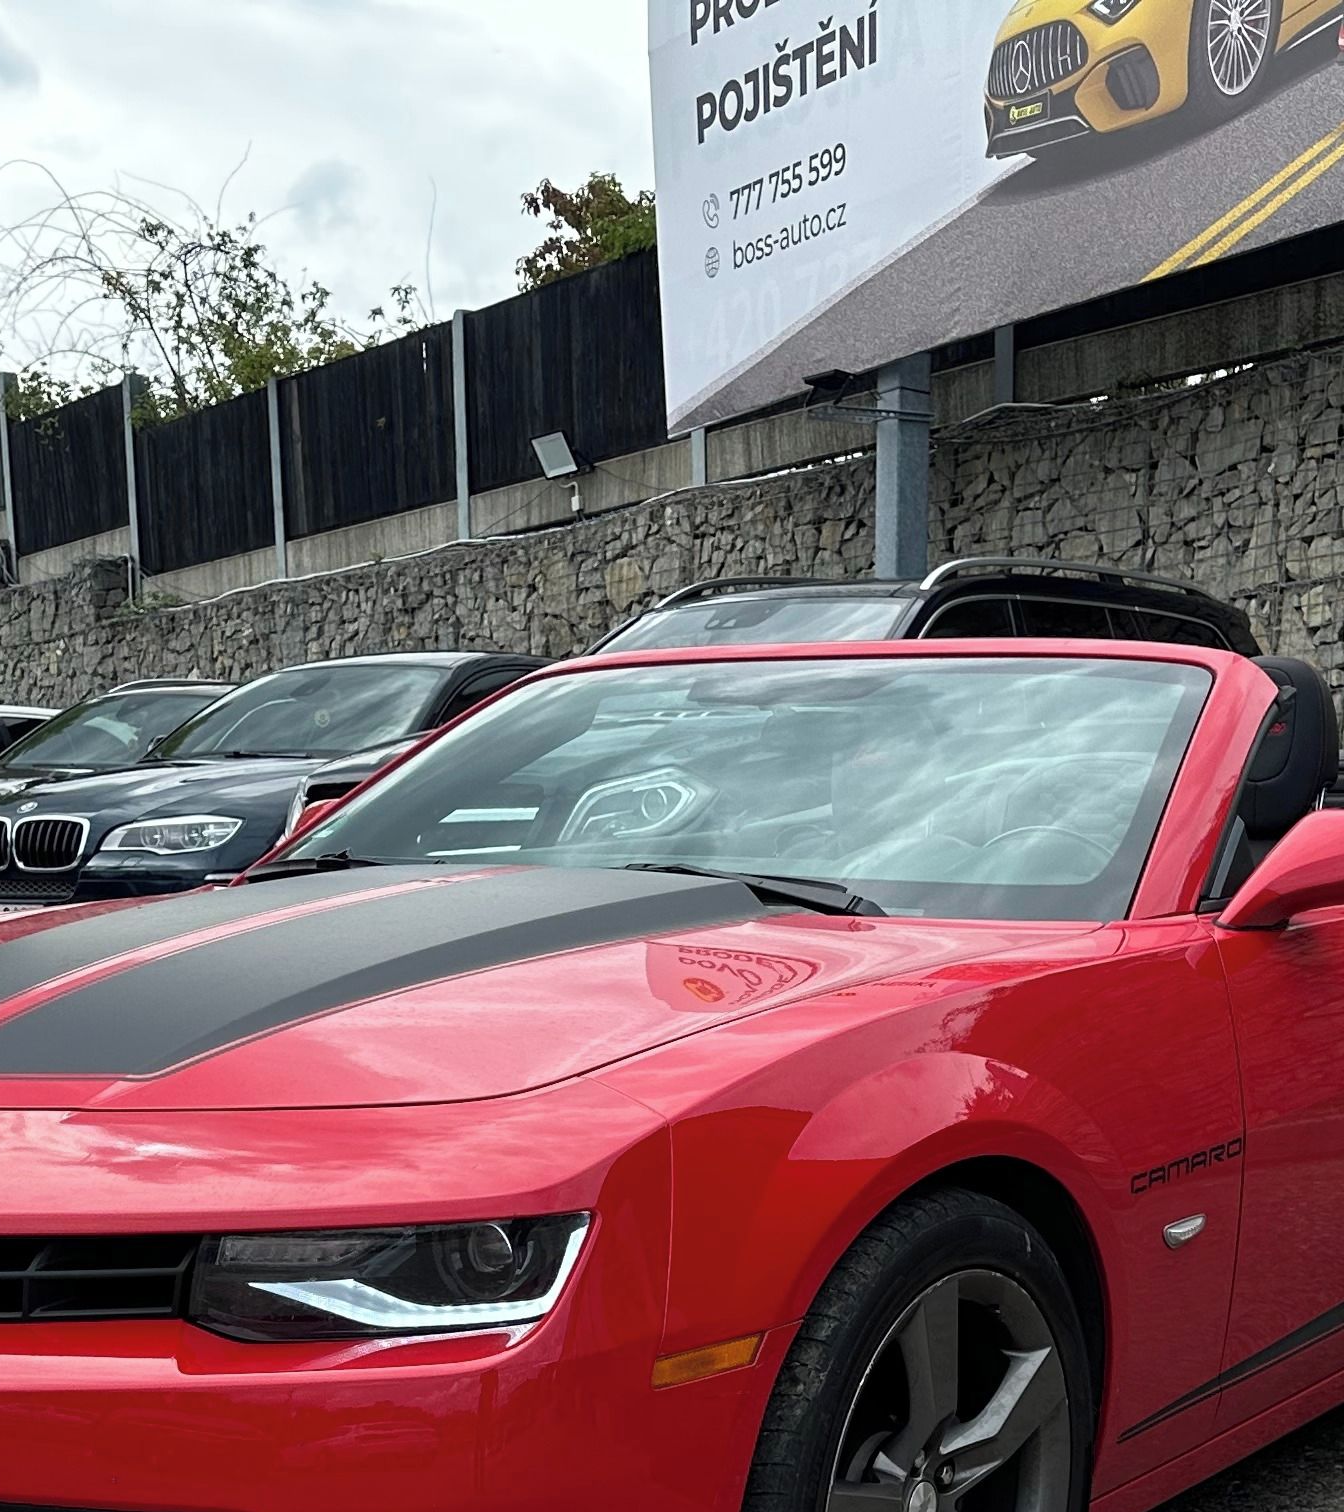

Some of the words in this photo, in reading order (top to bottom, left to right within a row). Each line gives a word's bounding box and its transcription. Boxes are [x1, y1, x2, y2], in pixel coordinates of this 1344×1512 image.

[696, 0, 877, 145] POJIŠTĚNÍ
[729, 177, 764, 220] 777
[768, 160, 803, 203] 755
[807, 142, 847, 187] 599
[732, 202, 847, 270] boss-auto.cz
[1130, 1137, 1242, 1194] CAMARO
